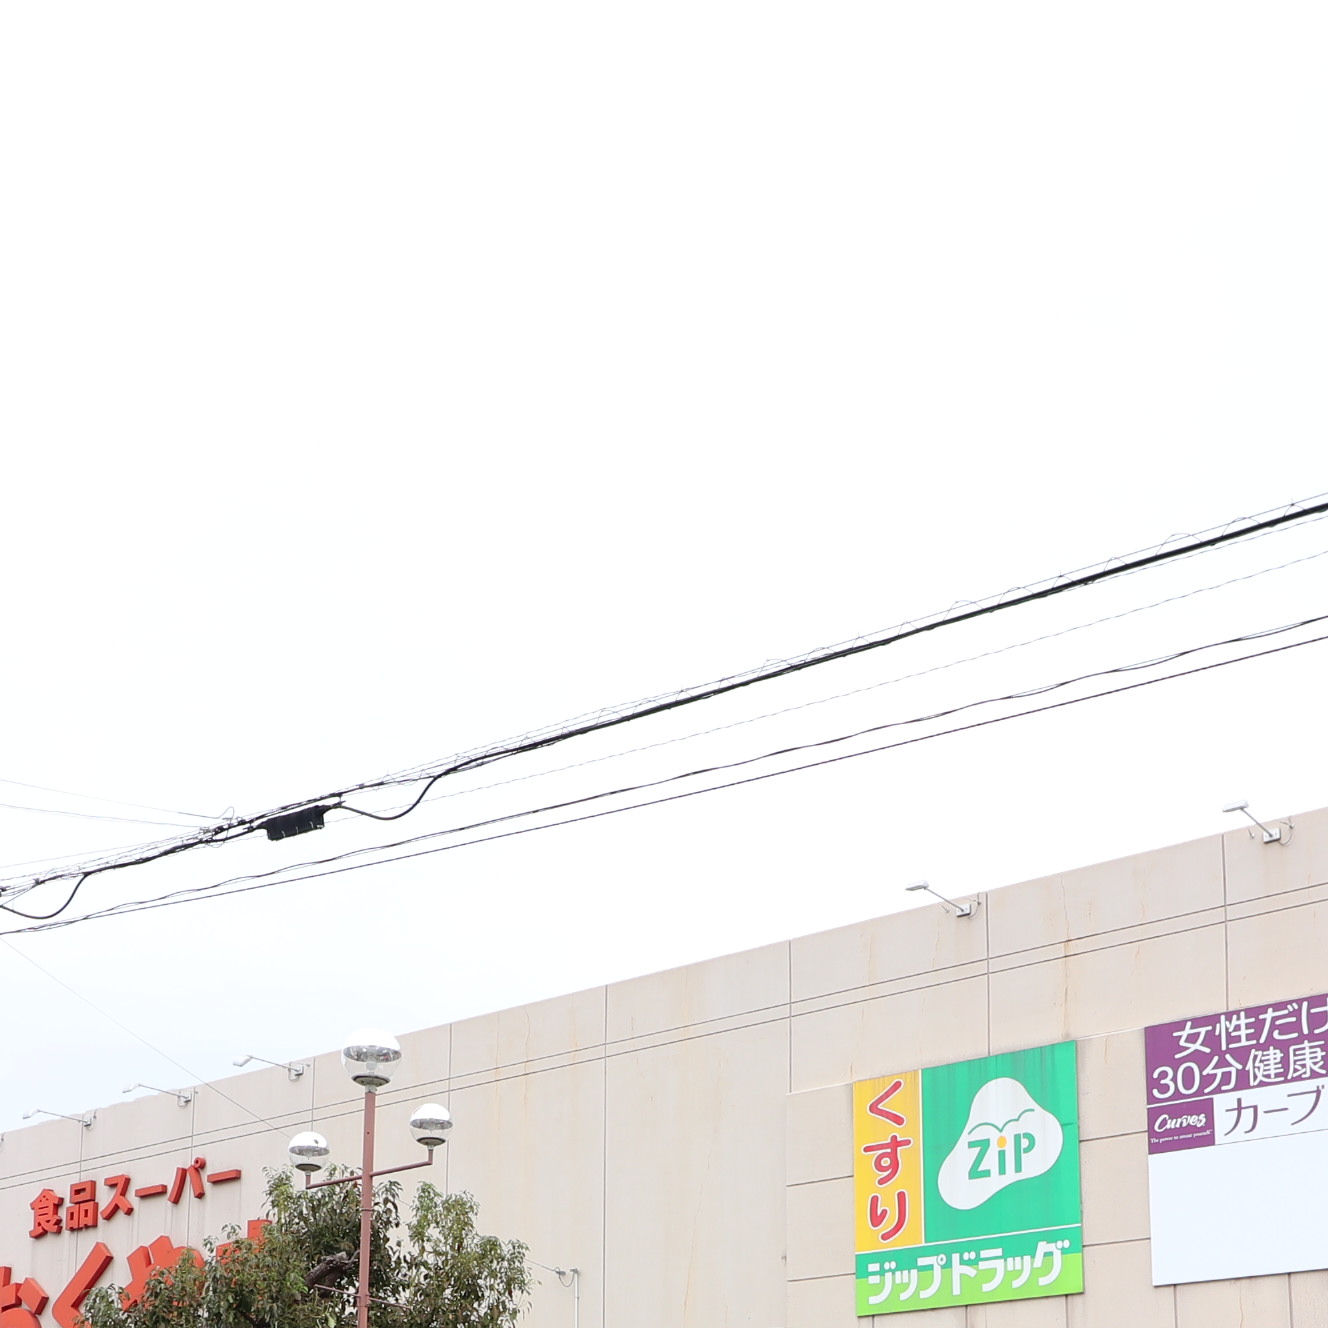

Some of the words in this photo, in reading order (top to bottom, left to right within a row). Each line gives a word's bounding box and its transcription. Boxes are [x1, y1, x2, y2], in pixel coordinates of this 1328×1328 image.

[1154, 1113, 1207, 1132] Curves
[862, 1079, 913, 1242] くすり
[29, 1157, 242, 1240] 食品スーパー
[867, 1239, 1070, 1305] ジップドラッグ
